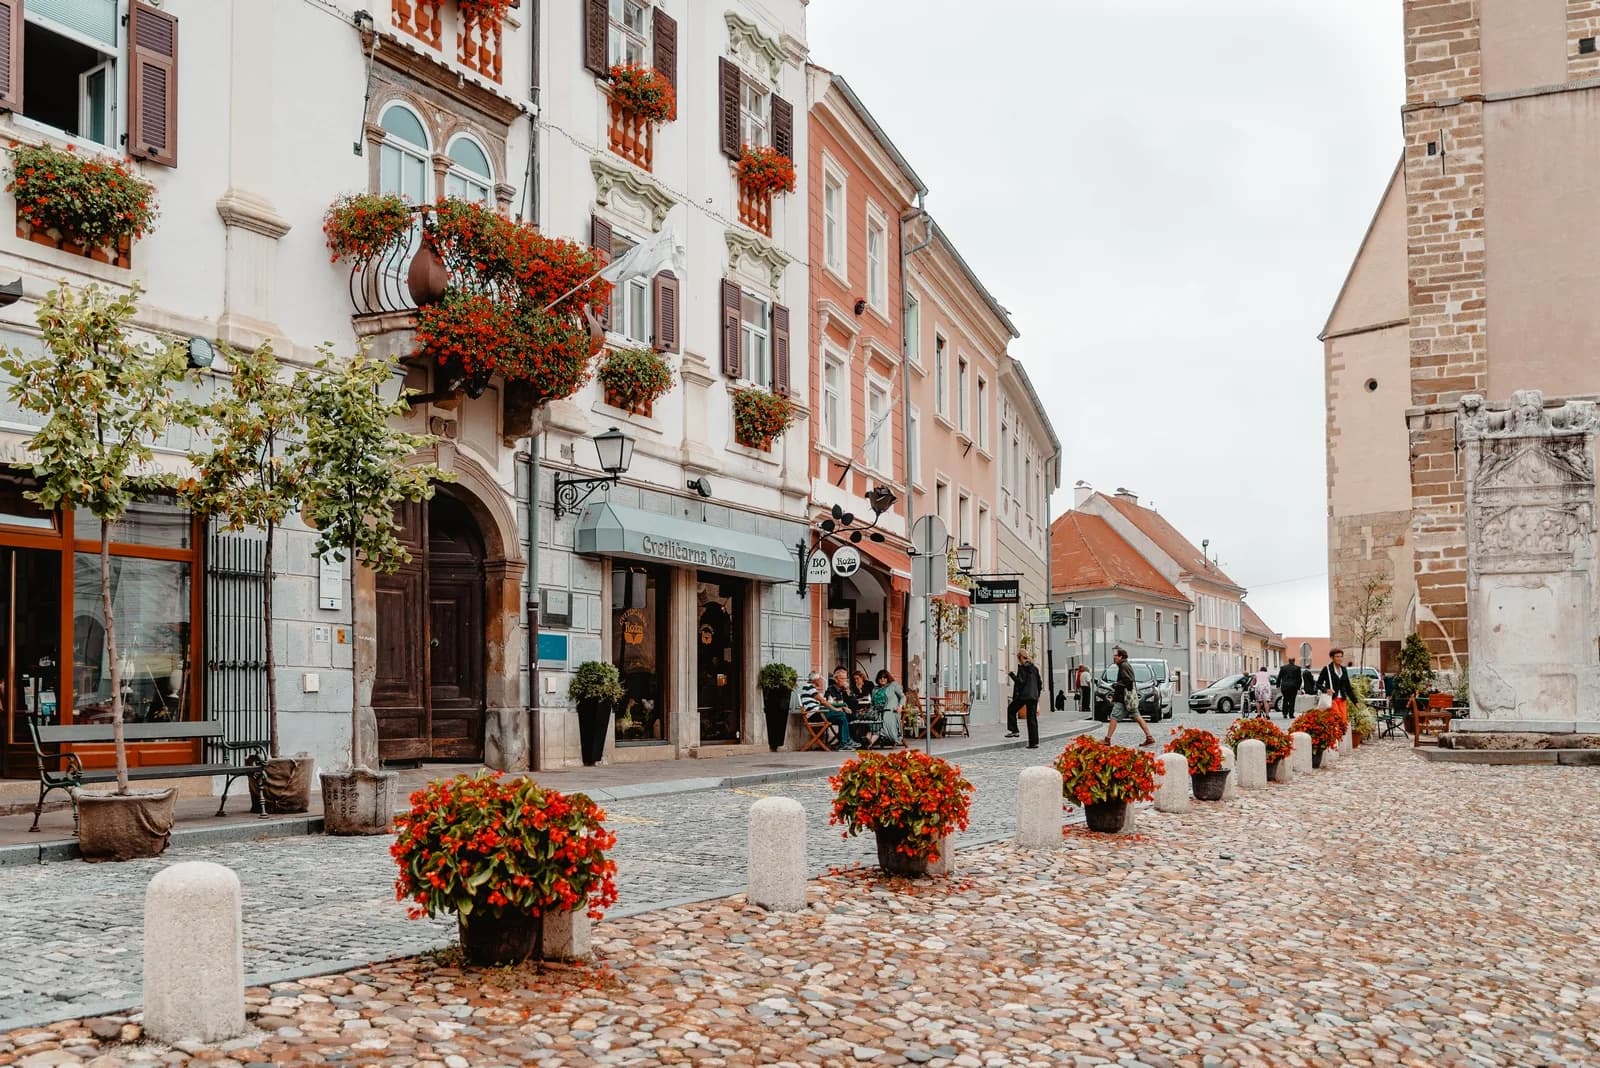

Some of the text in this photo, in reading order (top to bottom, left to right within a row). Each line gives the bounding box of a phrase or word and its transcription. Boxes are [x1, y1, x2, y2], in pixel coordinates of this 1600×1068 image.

[642, 535, 736, 569] Cvetličarna Roža
[812, 558, 827, 568] BO
